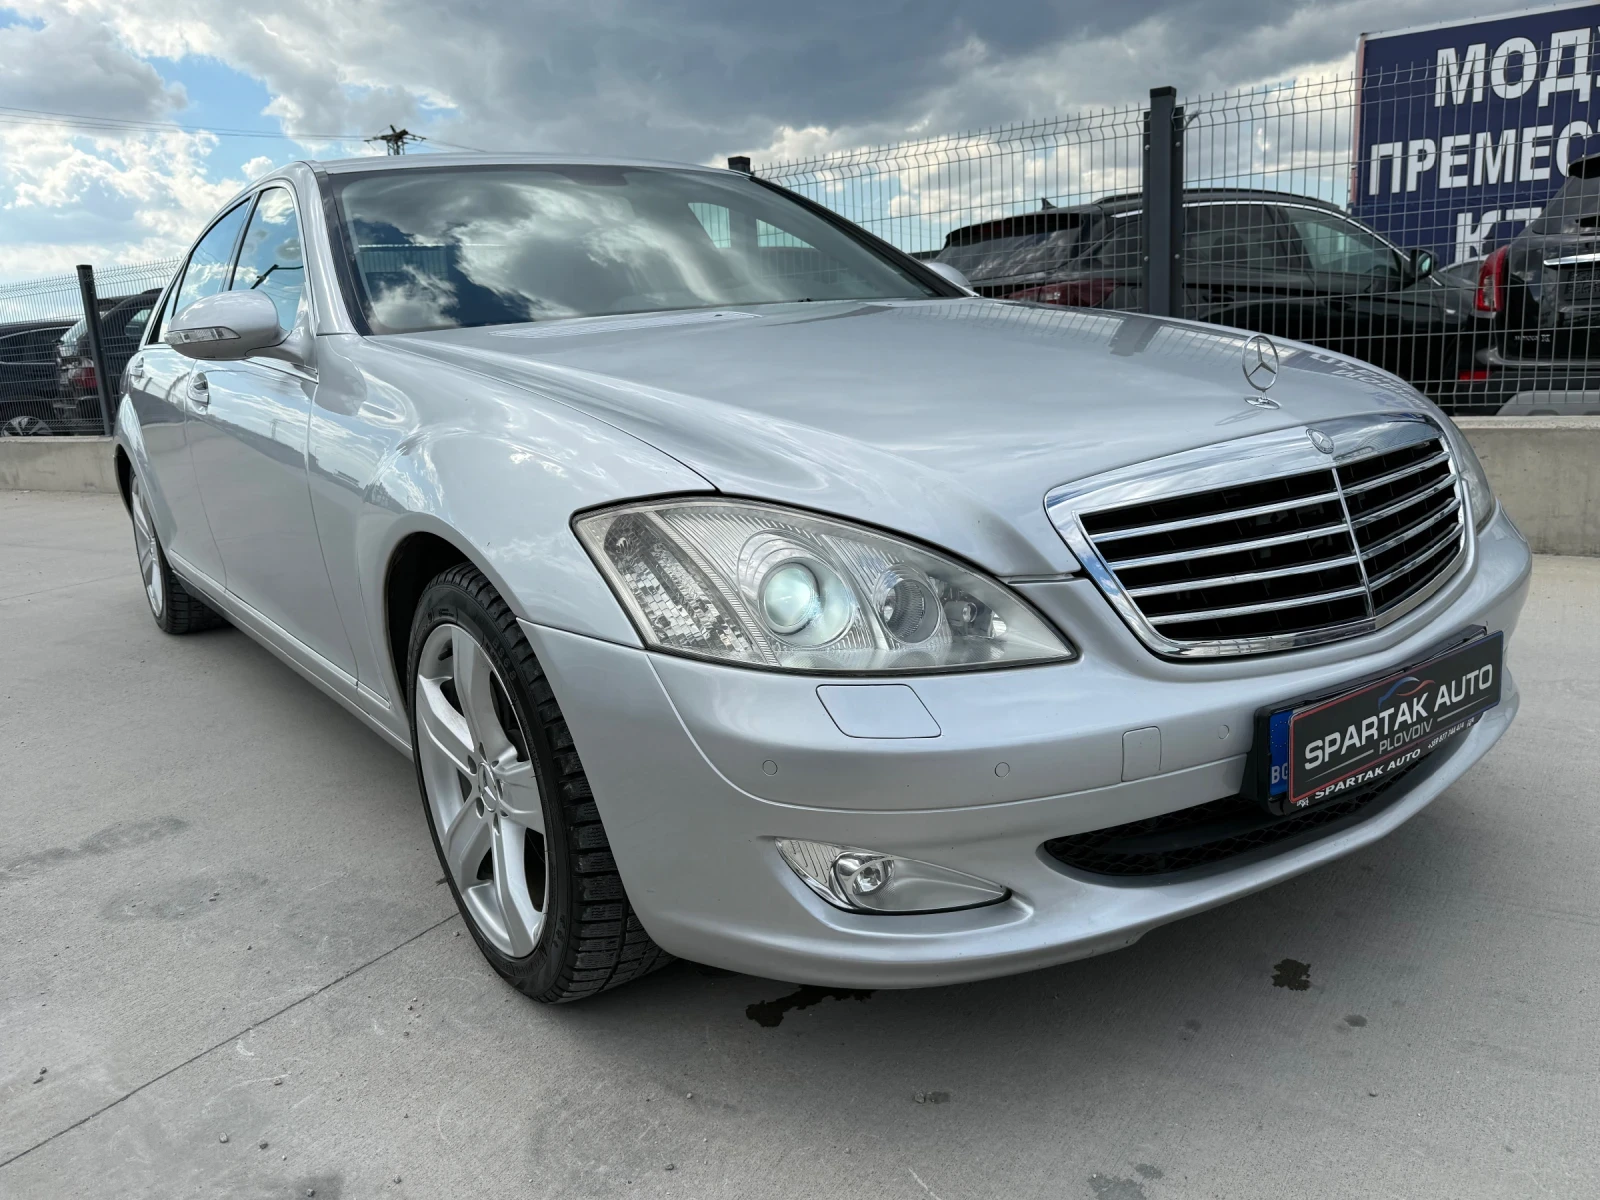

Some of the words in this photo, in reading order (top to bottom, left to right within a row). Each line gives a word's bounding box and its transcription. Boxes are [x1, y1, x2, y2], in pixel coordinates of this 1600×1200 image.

[1434, 26, 1600, 107] МОД
[1369, 120, 1600, 195] ПРЕМЕС
[1304, 692, 1428, 770] SPARTAK
[1434, 664, 1493, 712] AUTO
[1379, 718, 1433, 755] PLOVDIV
[1315, 765, 1384, 799] SPARTAK
[1387, 748, 1421, 771] AUTO
